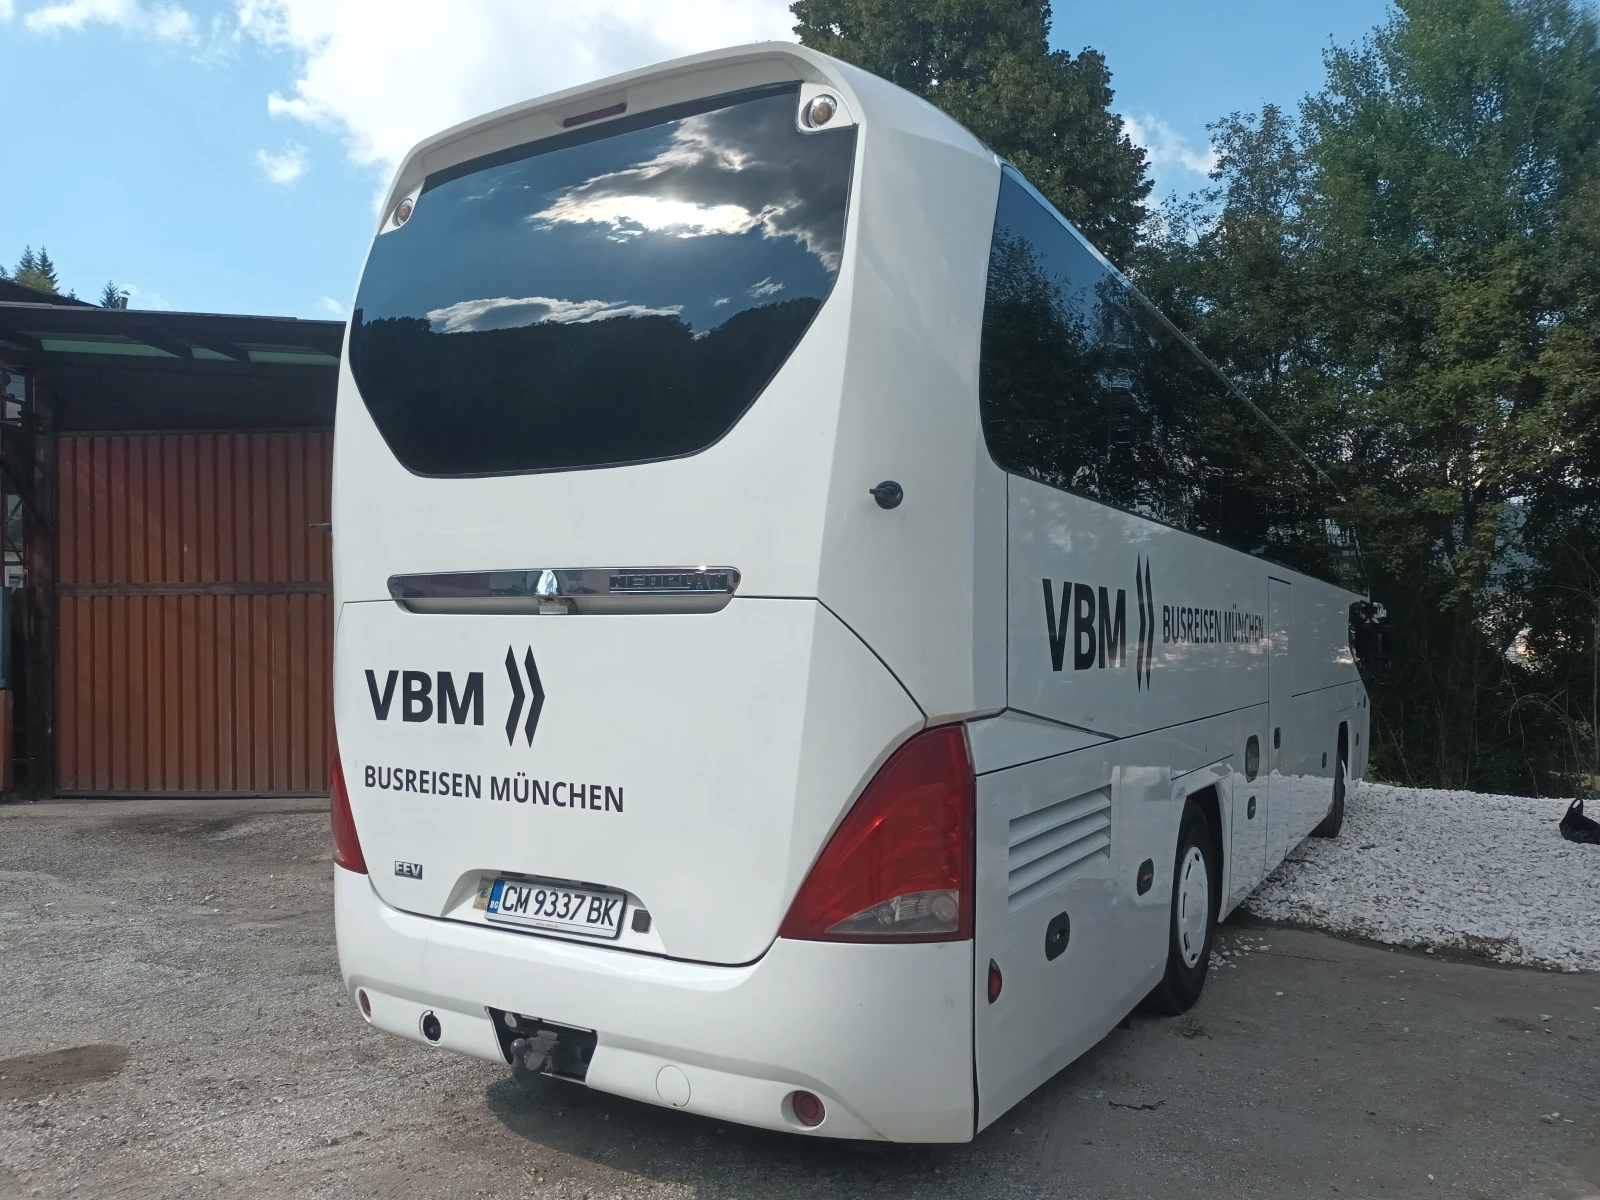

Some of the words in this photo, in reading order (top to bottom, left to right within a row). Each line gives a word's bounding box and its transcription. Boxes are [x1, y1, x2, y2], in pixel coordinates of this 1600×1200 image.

[609, 572, 728, 592] NEOPLAN
[1042, 578, 1126, 671] VBM
[1163, 605, 1221, 644] BUSREISEN
[1224, 604, 1264, 644] MÜNCHEN
[365, 669, 484, 726] VBM
[365, 765, 481, 799] BUSREISEN
[490, 771, 624, 812] MÜNCHEN
[395, 861, 421, 878] EEV
[489, 900, 499, 909] BG
[502, 885, 532, 914] CM
[533, 889, 587, 921] 9337
[586, 896, 619, 927] BK
